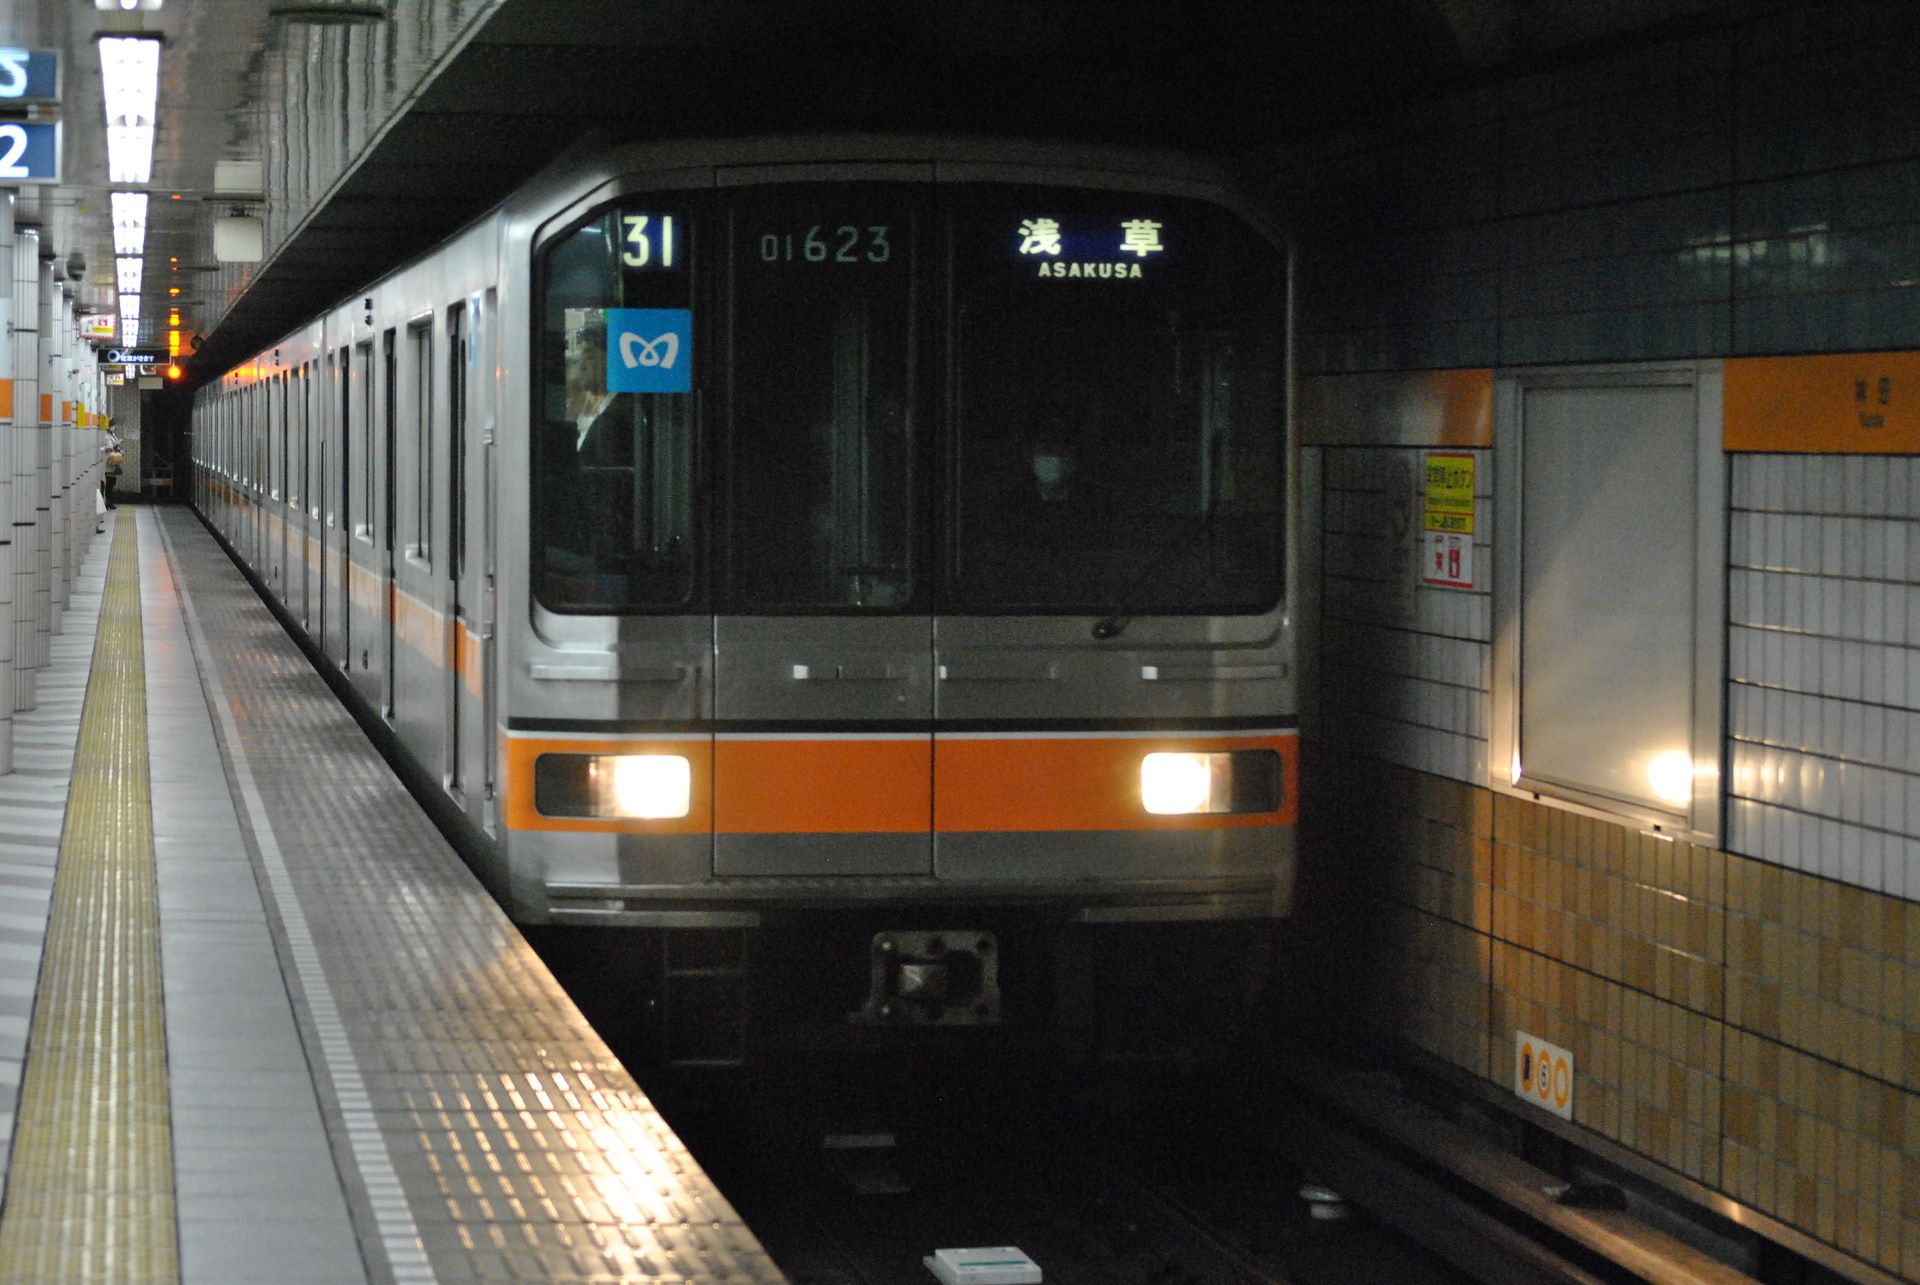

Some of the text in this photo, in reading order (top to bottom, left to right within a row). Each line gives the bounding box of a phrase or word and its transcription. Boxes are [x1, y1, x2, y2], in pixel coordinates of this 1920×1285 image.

[0, 124, 30, 178] 2
[623, 215, 673, 267] 31
[1018, 218, 1164, 257] 浅草
[1038, 262, 1142, 278] ASAKUSA
